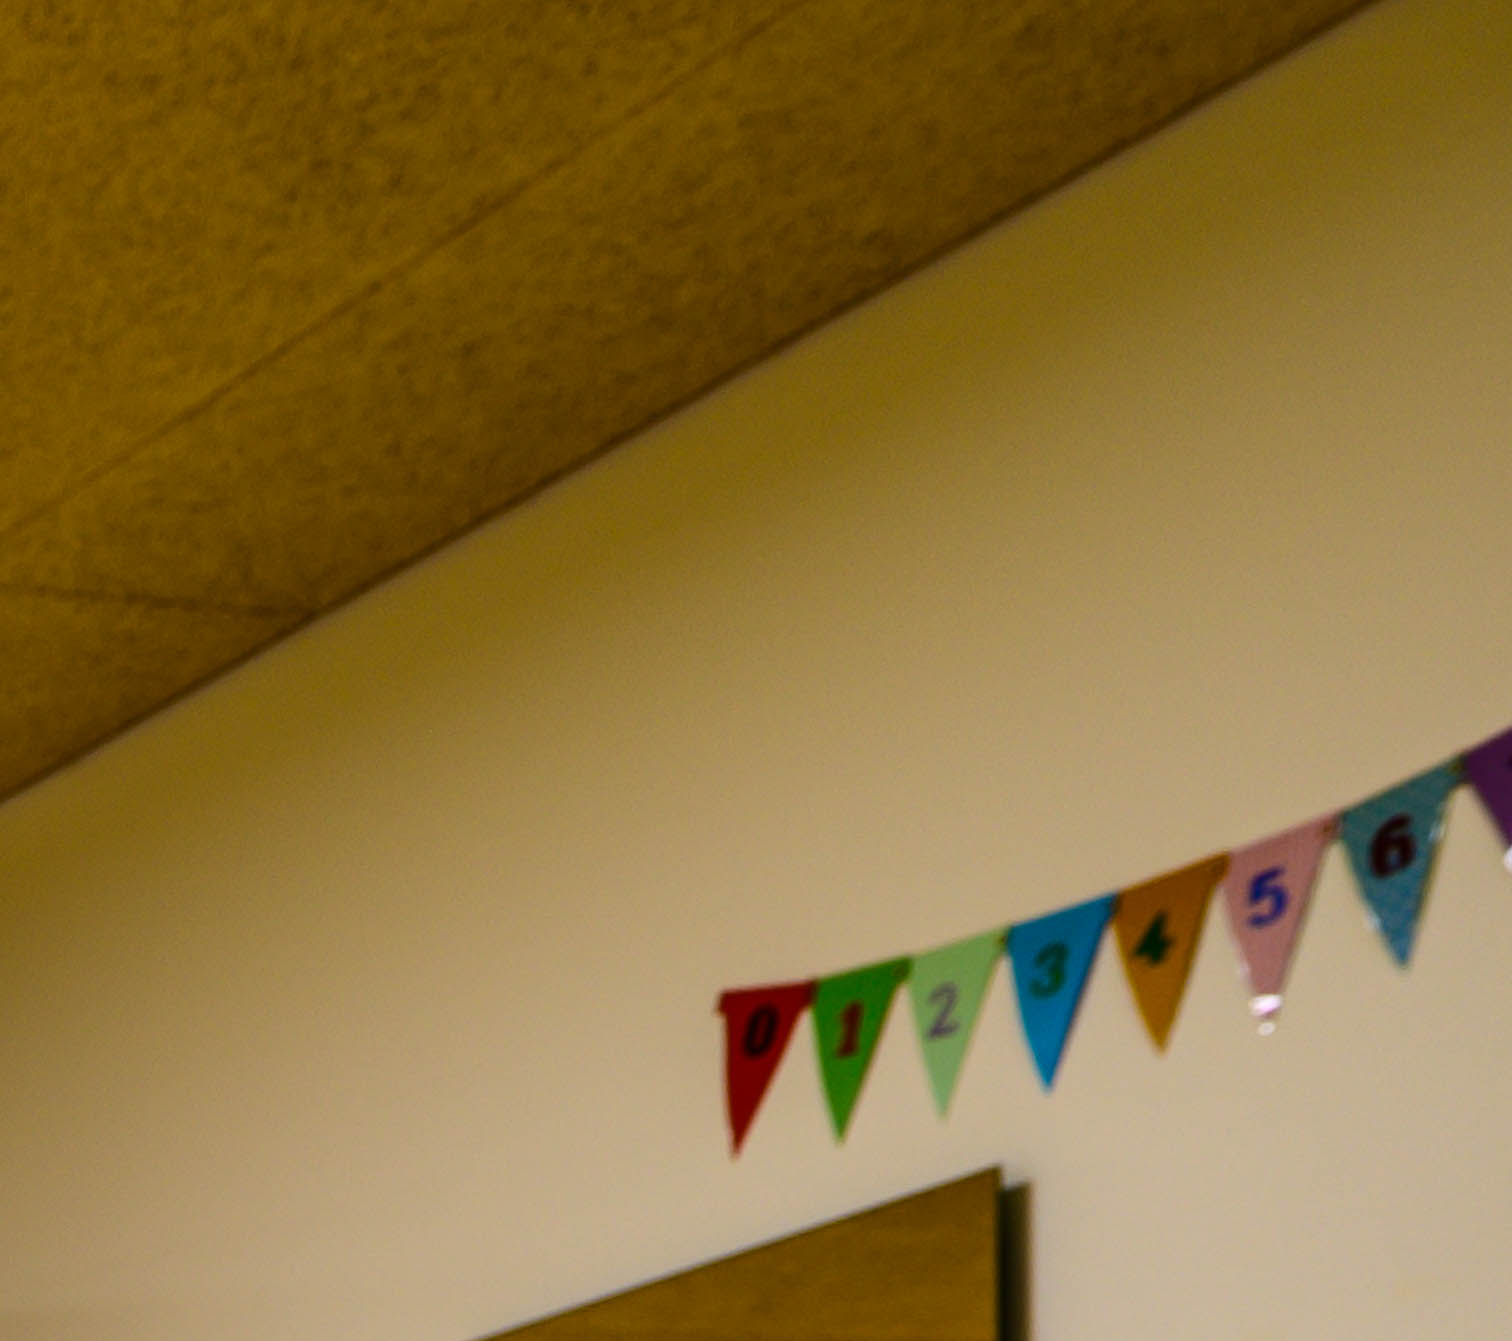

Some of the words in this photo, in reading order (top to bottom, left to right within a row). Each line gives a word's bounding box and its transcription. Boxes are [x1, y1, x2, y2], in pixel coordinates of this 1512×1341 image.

[742, 1003, 779, 1058] 0
[835, 1001, 862, 1058] 1
[927, 982, 958, 1039] 2
[1030, 943, 1068, 997] 3
[1133, 911, 1174, 965] 4
[1247, 868, 1289, 928] 5
[1369, 814, 1416, 878] 6
